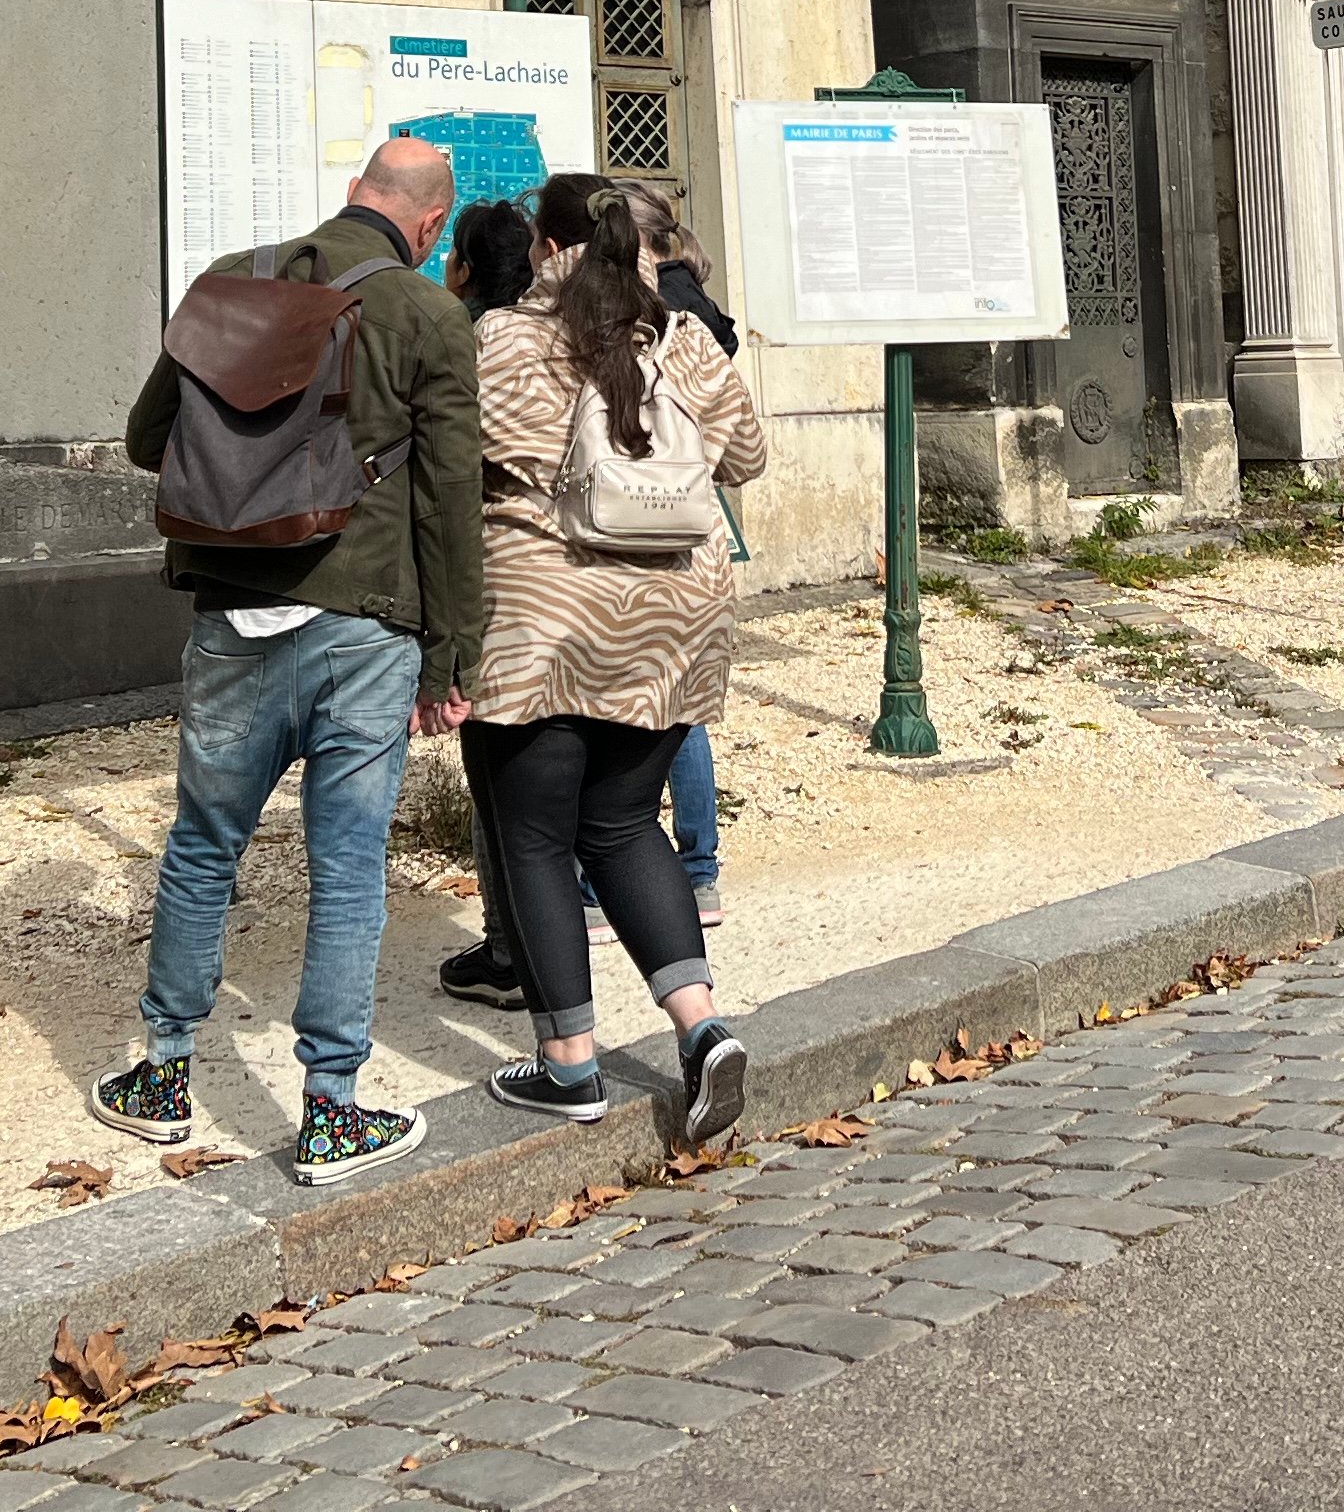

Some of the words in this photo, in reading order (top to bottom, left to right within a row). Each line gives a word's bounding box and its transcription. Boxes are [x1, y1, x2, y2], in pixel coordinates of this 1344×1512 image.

[394, 37, 464, 55] Cimetière
[391, 54, 419, 79] du
[428, 58, 569, 85] Père-Lachaise
[790, 127, 830, 139] MAIRIE
[833, 128, 849, 139] DE
[851, 128, 883, 140] PARIS
[623, 485, 691, 494] REPLAY
